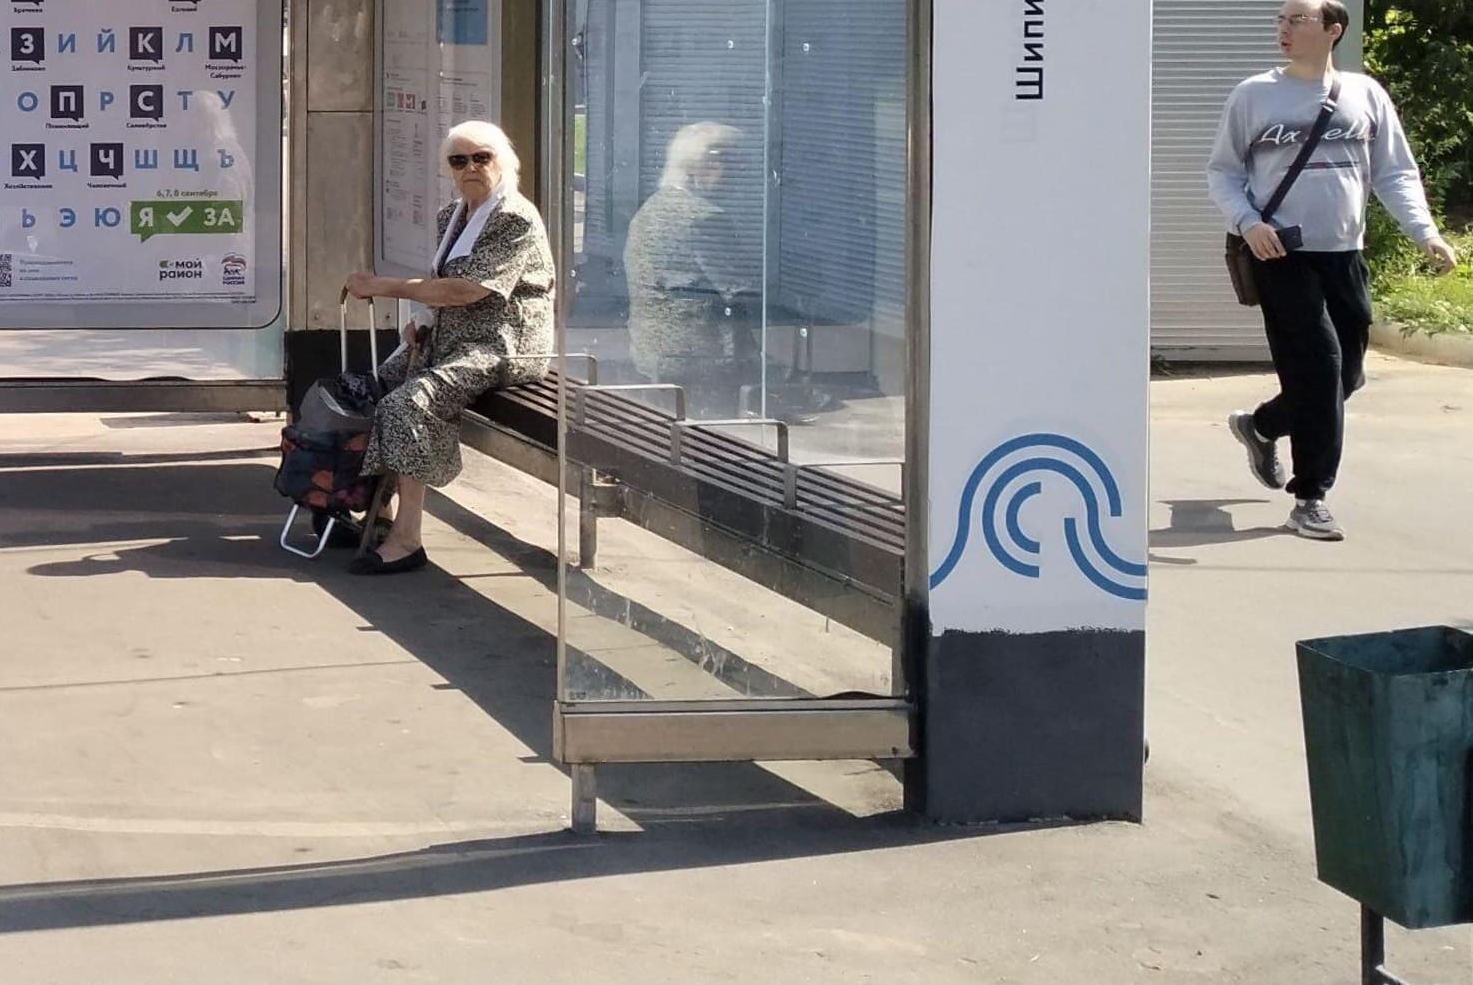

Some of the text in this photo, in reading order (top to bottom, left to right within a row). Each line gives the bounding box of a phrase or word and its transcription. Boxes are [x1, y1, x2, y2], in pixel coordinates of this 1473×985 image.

[20, 34, 34, 54] З
[58, 34, 76, 53] И
[97, 28, 115, 53] Й
[138, 33, 155, 53] К
[175, 33, 193, 53] Л
[214, 32, 236, 53] М
[17, 92, 39, 112] О
[59, 91, 76, 112] П
[100, 91, 114, 111] Р
[137, 91, 154, 111] С
[177, 91, 193, 111] Т
[217, 90, 235, 111] У
[19, 150, 38, 171] Х
[59, 150, 78, 172] Ц
[99, 150, 115, 170] Ч
[135, 150, 158, 169] Ш
[174, 149, 199, 172] Щ
[217, 149, 235, 168] Ъ
[22, 208, 36, 228] Ь
[59, 208, 76, 227] Э
[95, 207, 121, 227] Ю
[138, 207, 153, 227] Я
[203, 207, 236, 227] ЗА
[175, 258, 202, 269] мой
[159, 270, 202, 281] район
